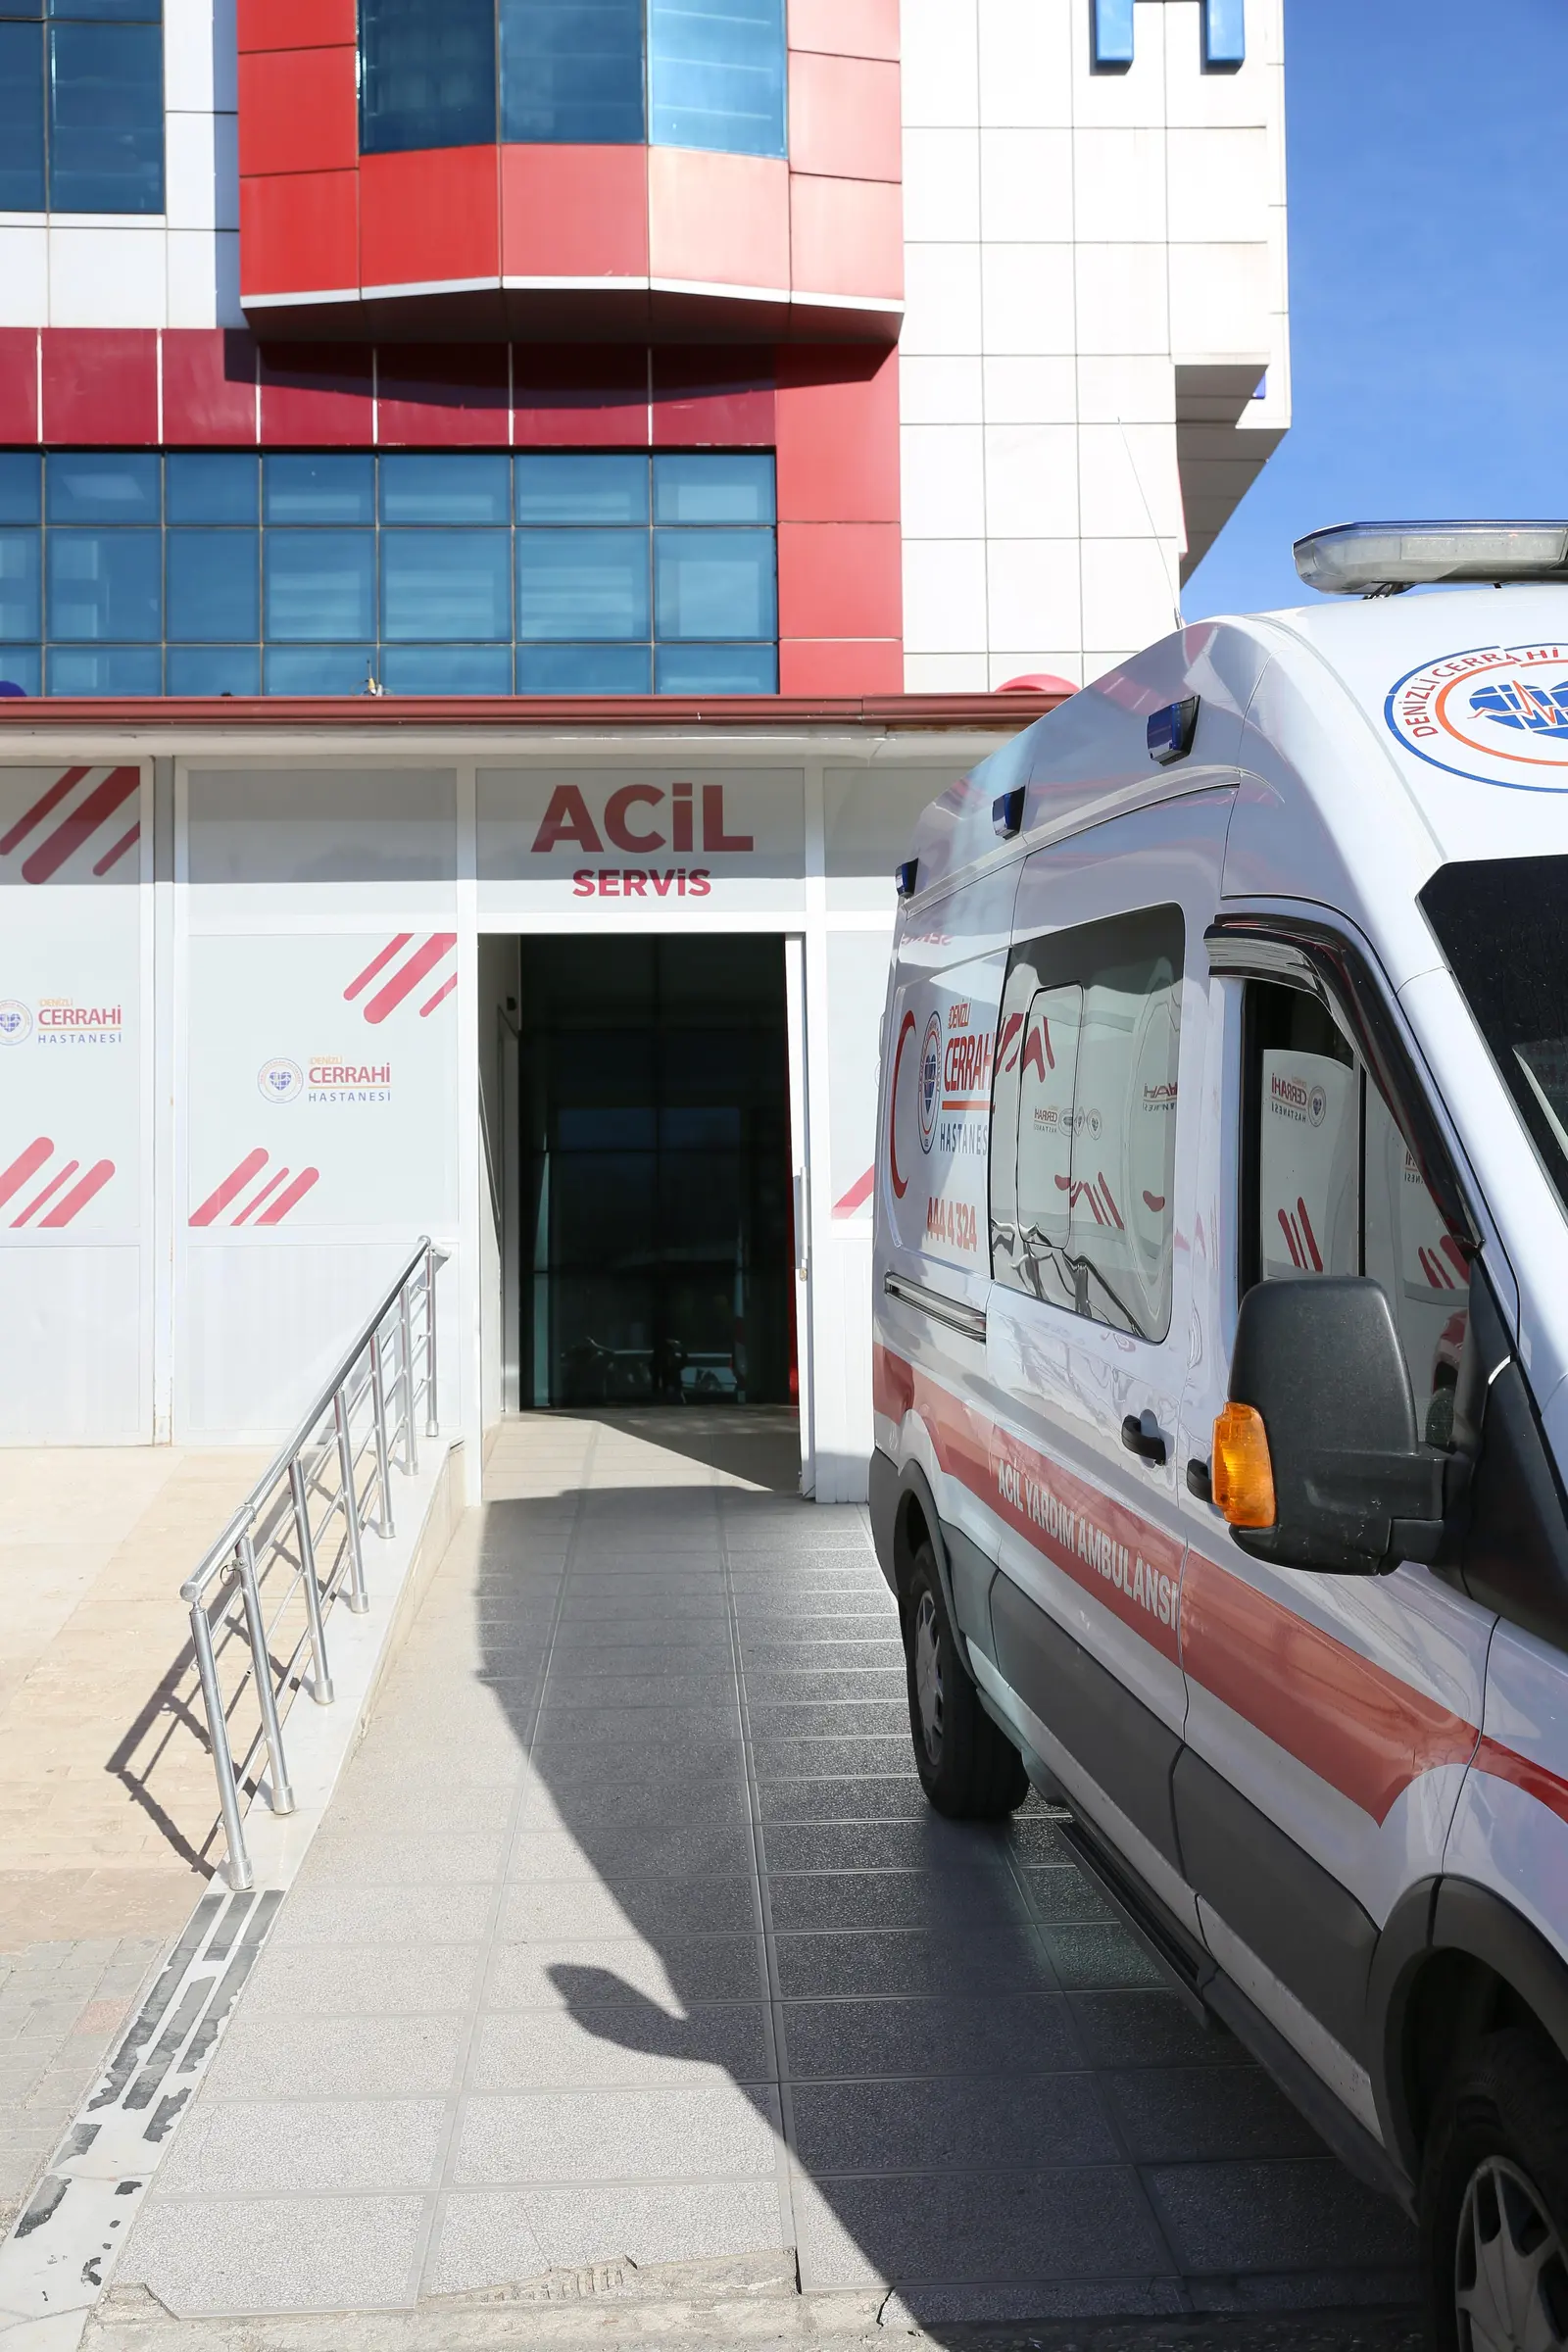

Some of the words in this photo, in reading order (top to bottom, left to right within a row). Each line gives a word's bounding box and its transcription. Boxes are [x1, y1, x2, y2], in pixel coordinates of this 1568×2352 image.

[1398, 677, 1441, 738] DENİZLİ
[1432, 647, 1559, 678] CERRAHİ
[38, 1004, 122, 1025] CERRAHİ
[38, 1032, 122, 1044] HASTANESİ
[309, 1062, 390, 1084] CERRAHİ
[944, 1034, 995, 1092] CERRAH
[309, 1090, 391, 1102] HASTANESİ
[940, 1122, 989, 1156] HASTANES
[926, 1197, 946, 1244] 444
[947, 1200, 955, 1246] 4
[956, 1202, 978, 1252] 324
[1025, 1478, 1075, 1553] YARDIM
